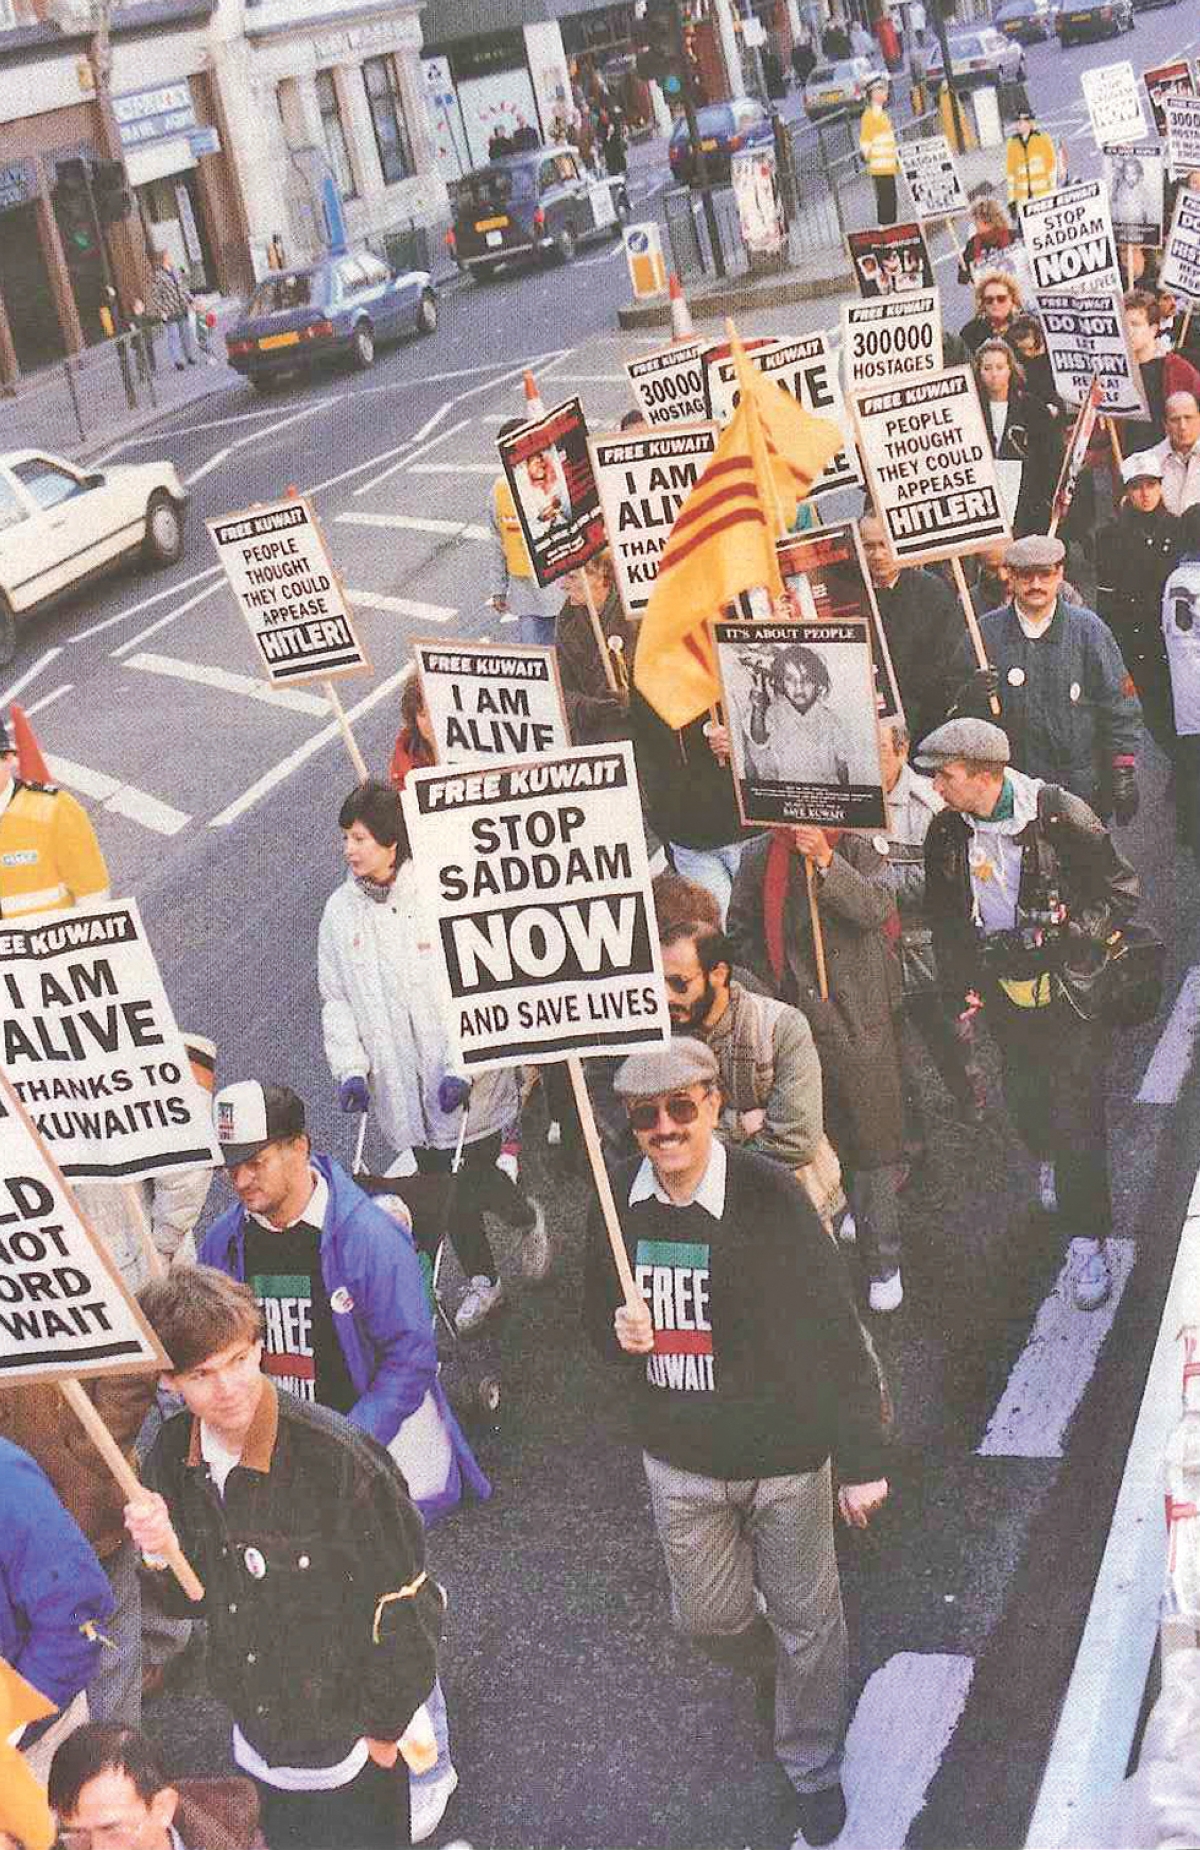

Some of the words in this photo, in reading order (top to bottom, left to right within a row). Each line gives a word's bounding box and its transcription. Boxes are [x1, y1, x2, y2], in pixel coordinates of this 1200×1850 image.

[1171, 113, 1200, 127] 3000
[1033, 218, 1104, 250] SADDAM
[1044, 206, 1085, 230] STOP
[1037, 238, 1108, 287] NOW
[852, 306, 883, 323] FREE
[886, 300, 933, 317] KUWAIT
[1048, 315, 1075, 333] DO
[1079, 317, 1113, 336] NOT
[766, 341, 819, 369] KUWAIT
[853, 323, 933, 358] 300000
[854, 354, 934, 379] HOSTAGES
[1054, 351, 1126, 375] HISTORY
[641, 370, 701, 407] 30000
[864, 393, 901, 414] FREE
[906, 379, 965, 402] KUWAIT
[648, 398, 705, 424] HOSTAG
[886, 408, 954, 436] PEOPLE
[604, 443, 645, 463] FREE
[650, 435, 711, 459] KUWAIT
[885, 428, 964, 459] THOUGHT
[625, 471, 636, 495] I
[649, 463, 698, 491] AM
[877, 460, 918, 483] THEY
[926, 446, 983, 471] COULD
[898, 468, 977, 499] APPEASE
[220, 524, 253, 542] FREE
[255, 509, 303, 533] KUWAIT
[889, 489, 996, 536] HITLER!
[243, 538, 300, 565] PEOPLE
[246, 557, 311, 585] THOUGHT
[243, 587, 277, 609] THEY
[282, 575, 330, 600] COULD
[262, 598, 328, 626] APPEASE
[261, 619, 351, 660] HITLER!
[726, 628, 750, 638] IT'S
[755, 628, 799, 639] ABOUT
[803, 628, 856, 639] PEOPLE
[428, 653, 473, 673] FREE
[476, 657, 543, 677] KUWAIT
[452, 684, 464, 711] I
[477, 687, 531, 717] AM
[446, 717, 554, 753] ALIVE
[428, 775, 501, 808] FREE
[510, 759, 621, 796] KUWAIT
[471, 807, 586, 855] STOP
[438, 843, 632, 901] SADDAM
[0, 935, 26, 955] EE
[30, 916, 128, 955] KUWAIT
[452, 896, 637, 988] NOW
[4, 973, 25, 1009] I
[40, 959, 119, 1008] AM
[460, 1004, 510, 1038] AND
[518, 995, 581, 1029] SAVE
[587, 987, 659, 1020] LIVES
[3, 1000, 164, 1065] ALIVE
[11, 1069, 134, 1103] THANKS
[140, 1062, 181, 1087] TO
[30, 1096, 192, 1140] KUWAITIS
[635, 1264, 713, 1331] FREE
[0, 1302, 113, 1341] WAIT
[256, 1297, 313, 1357] REE
